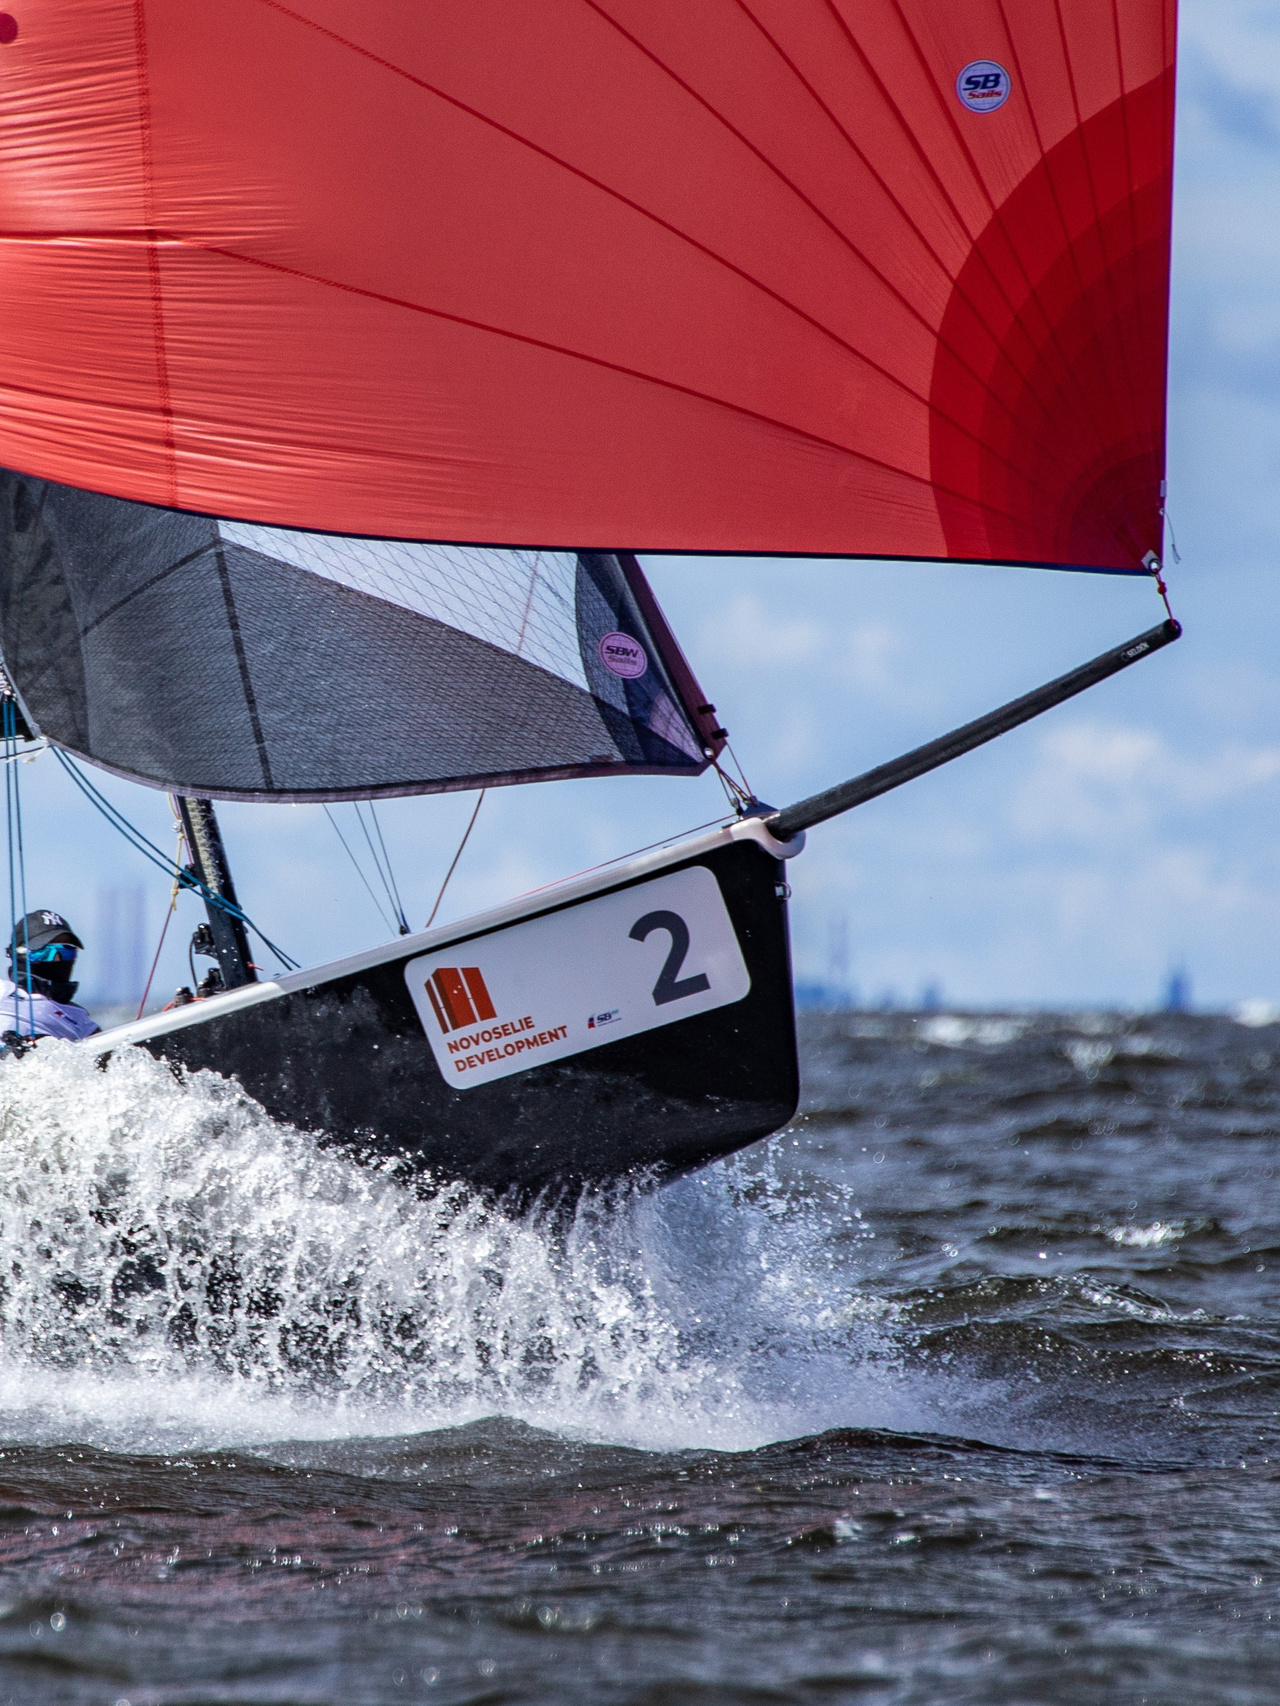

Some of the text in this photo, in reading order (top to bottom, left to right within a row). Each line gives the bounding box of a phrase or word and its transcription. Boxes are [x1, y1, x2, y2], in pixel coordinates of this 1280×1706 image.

[963, 73, 1001, 90] SB
[967, 90, 1003, 99] Sails
[605, 645, 639, 658] SBW
[628, 909, 711, 1006] 2
[447, 1015, 535, 1054] NOVOSELIE
[454, 1025, 568, 1073] DEVELOPMENT
